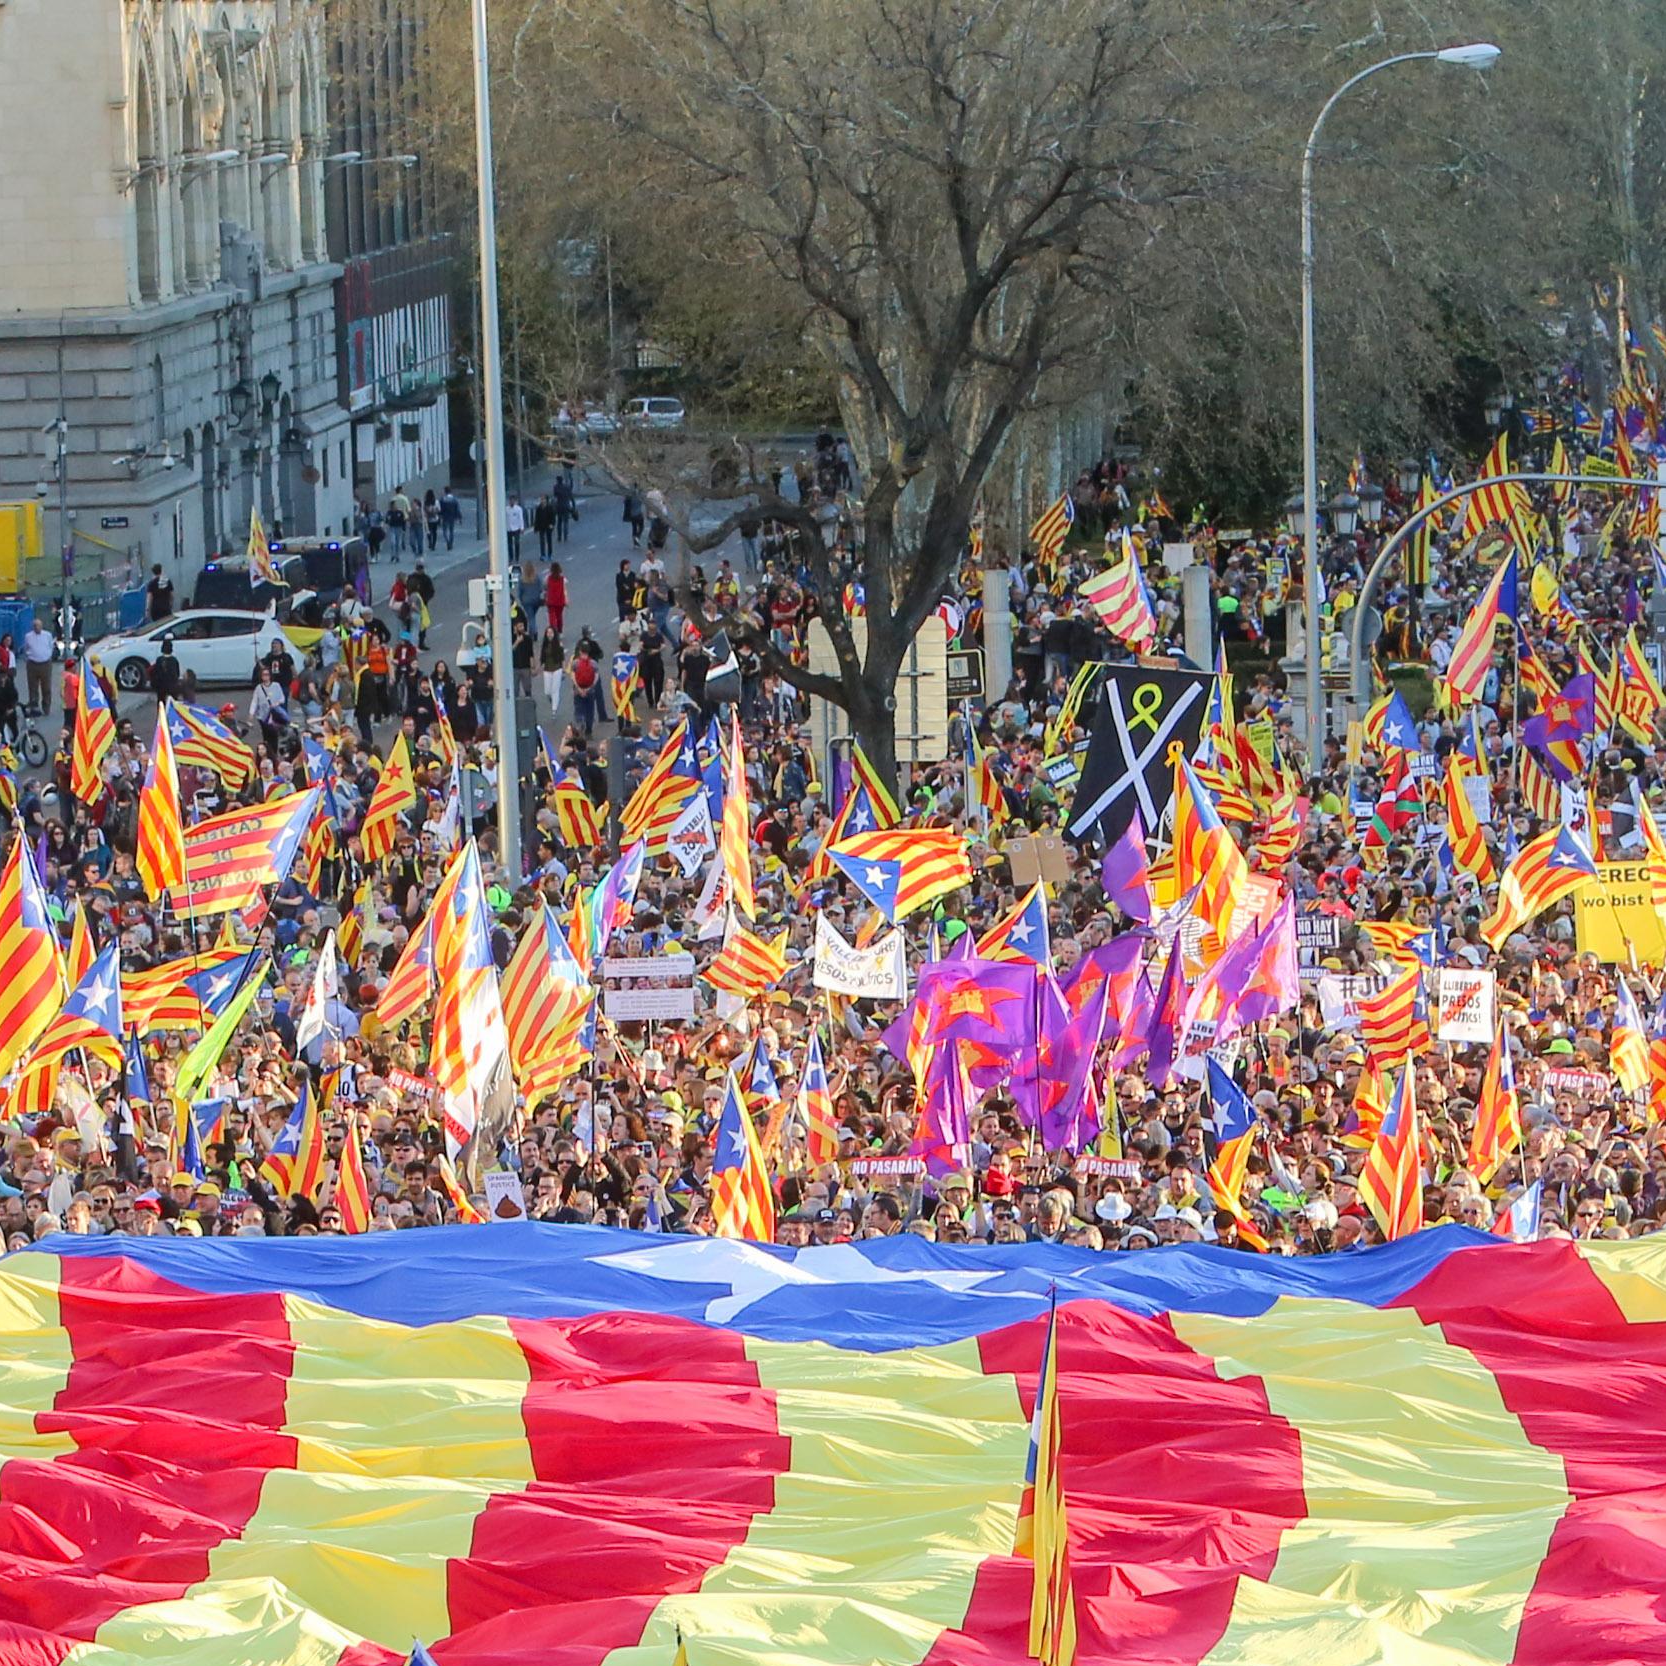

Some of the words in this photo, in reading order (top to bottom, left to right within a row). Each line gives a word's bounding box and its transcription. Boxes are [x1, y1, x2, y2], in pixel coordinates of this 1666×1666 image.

[1581, 896, 1607, 907] wo
[1611, 893, 1644, 908] bist
[1297, 919, 1311, 934] NO
[1313, 919, 1331, 933] HAY
[1442, 994, 1480, 1009] PRESOS
[852, 1161, 868, 1175] NO
